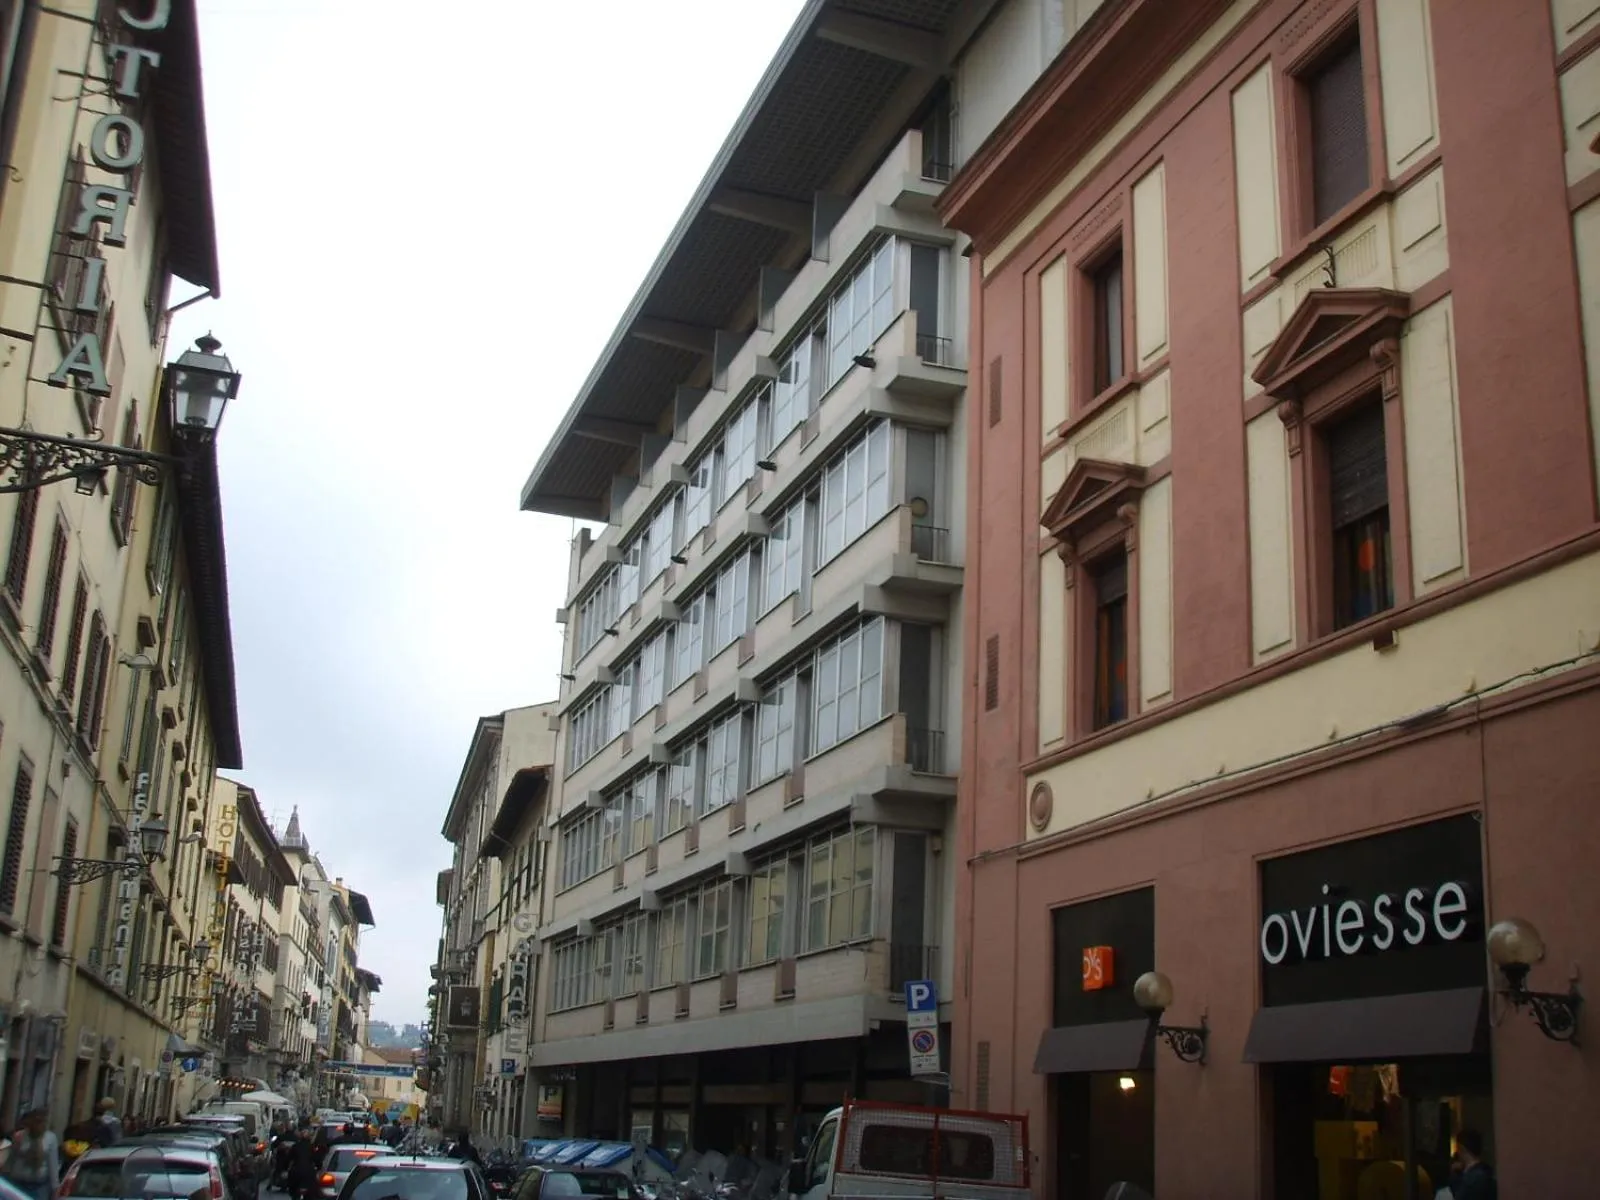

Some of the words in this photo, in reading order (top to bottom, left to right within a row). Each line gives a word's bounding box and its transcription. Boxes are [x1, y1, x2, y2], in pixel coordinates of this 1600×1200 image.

[1261, 880, 1468, 965] oviesse
[505, 913, 533, 1054] GARAGE
[910, 984, 930, 1009] P
[503, 1060, 513, 1073] P
